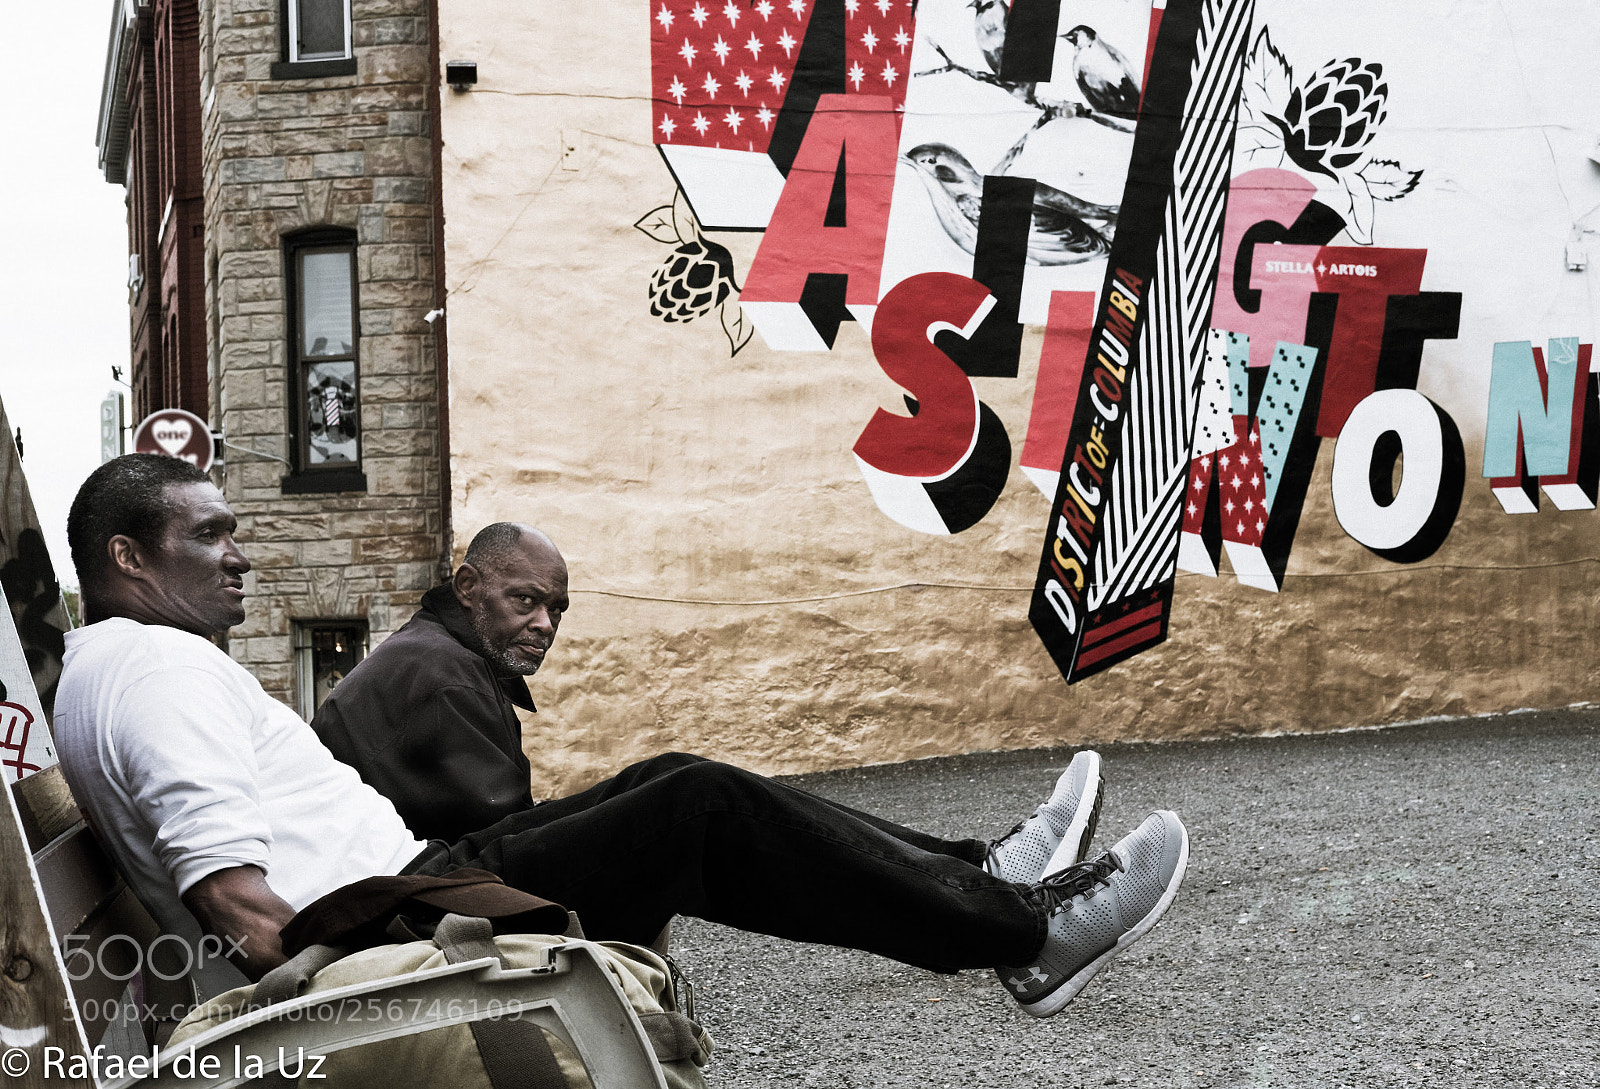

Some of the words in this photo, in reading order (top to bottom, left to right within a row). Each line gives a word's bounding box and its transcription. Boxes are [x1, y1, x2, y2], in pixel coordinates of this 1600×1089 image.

[1265, 260, 1314, 274] STELLA
[1329, 263, 1378, 277] ARTOIS
[1089, 267, 1143, 422] COLUMBIA
[1085, 425, 1109, 469] OF
[1044, 444, 1103, 635] DISTRICT
